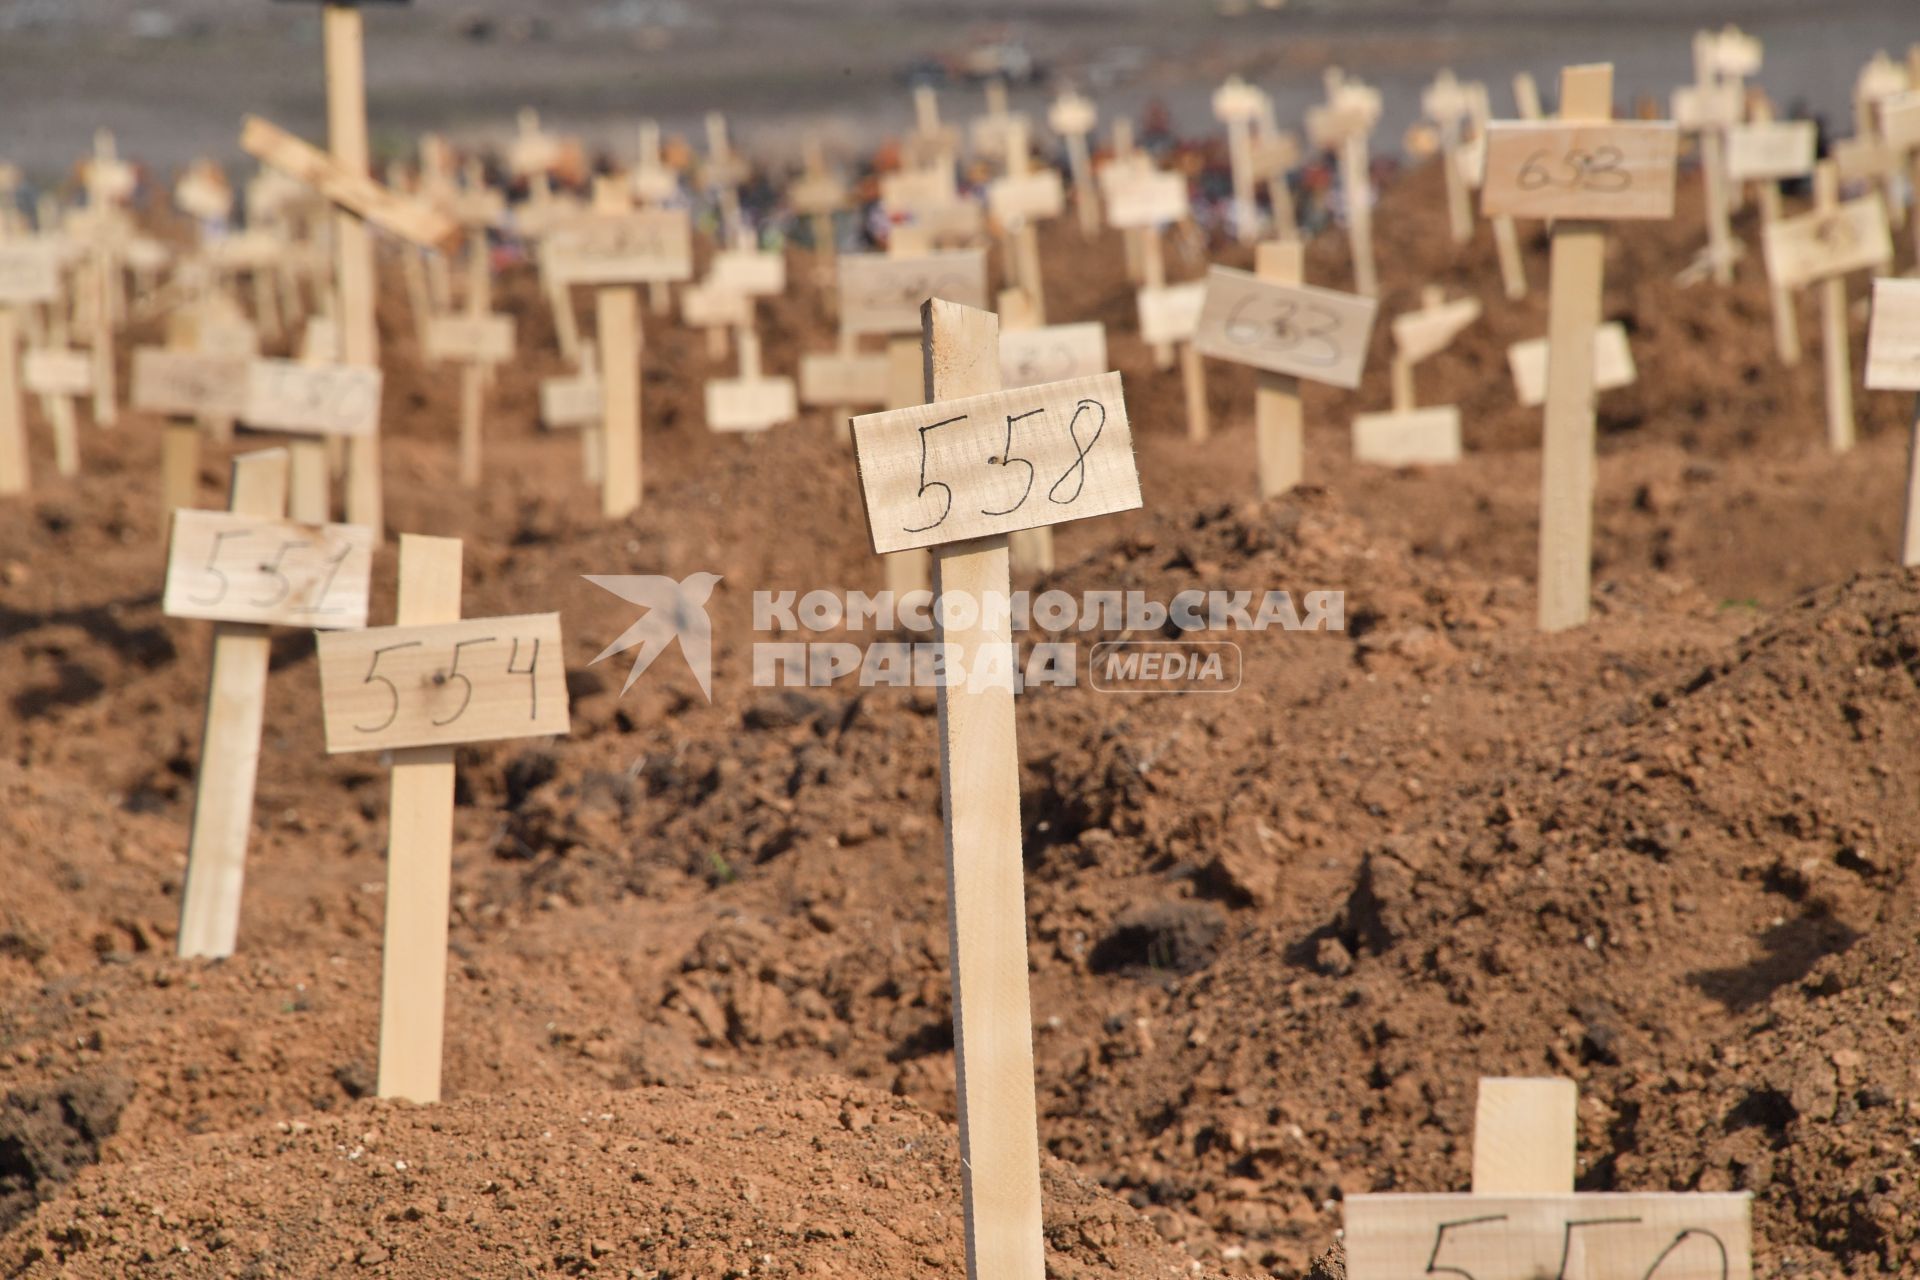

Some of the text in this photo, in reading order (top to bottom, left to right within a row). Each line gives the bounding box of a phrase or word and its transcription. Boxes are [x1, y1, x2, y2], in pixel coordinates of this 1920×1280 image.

[903, 398, 1106, 532] 558
[187, 530, 352, 614] 551
[354, 637, 539, 733] 554
